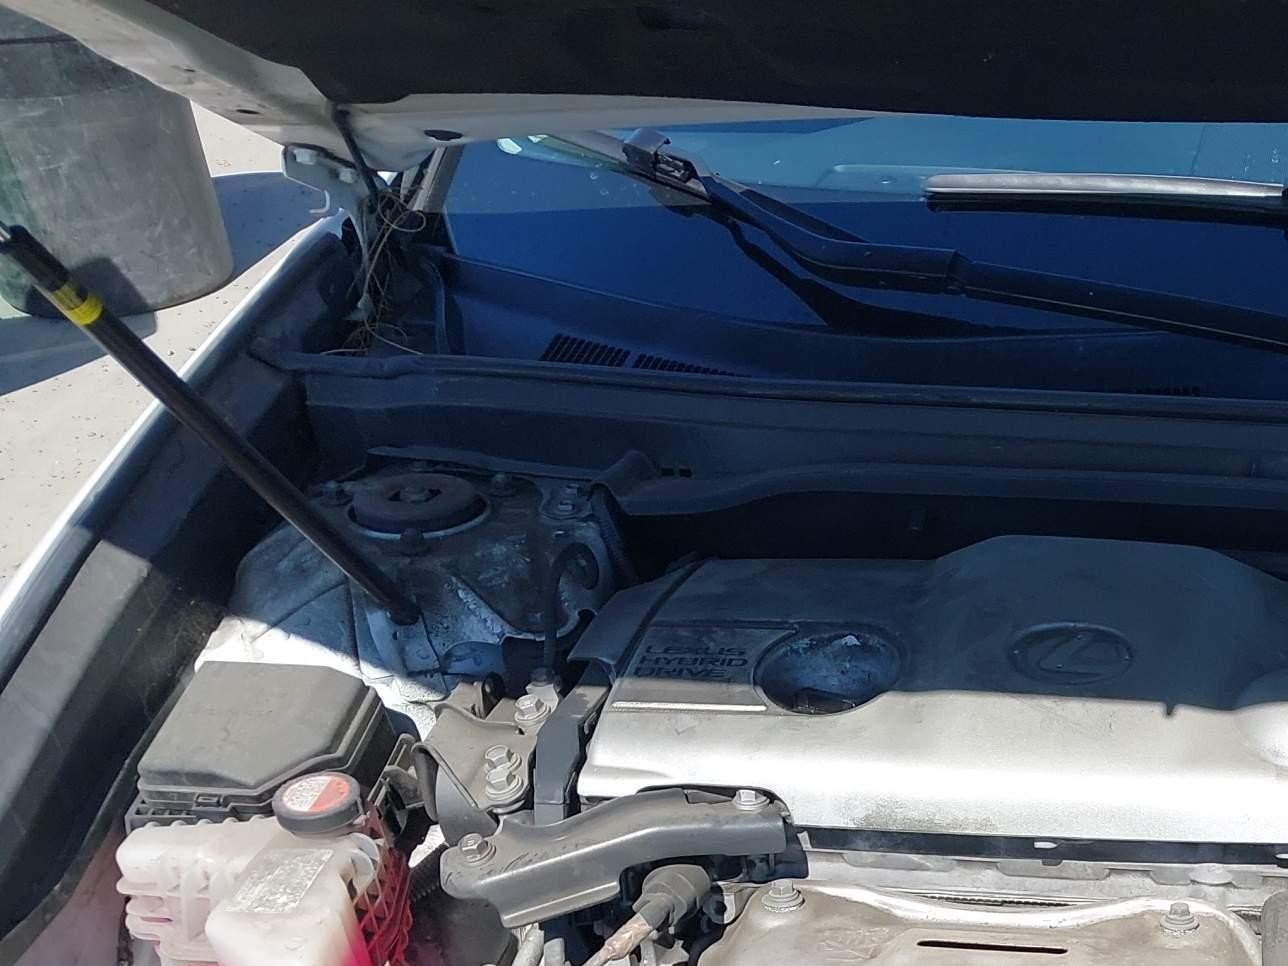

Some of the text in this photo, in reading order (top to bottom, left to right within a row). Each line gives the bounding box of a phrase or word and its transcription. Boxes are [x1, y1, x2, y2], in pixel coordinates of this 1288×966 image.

[645, 645, 747, 656] LEXUS
[639, 655, 749, 667] HYBRID
[633, 666, 730, 679] DRIVE
